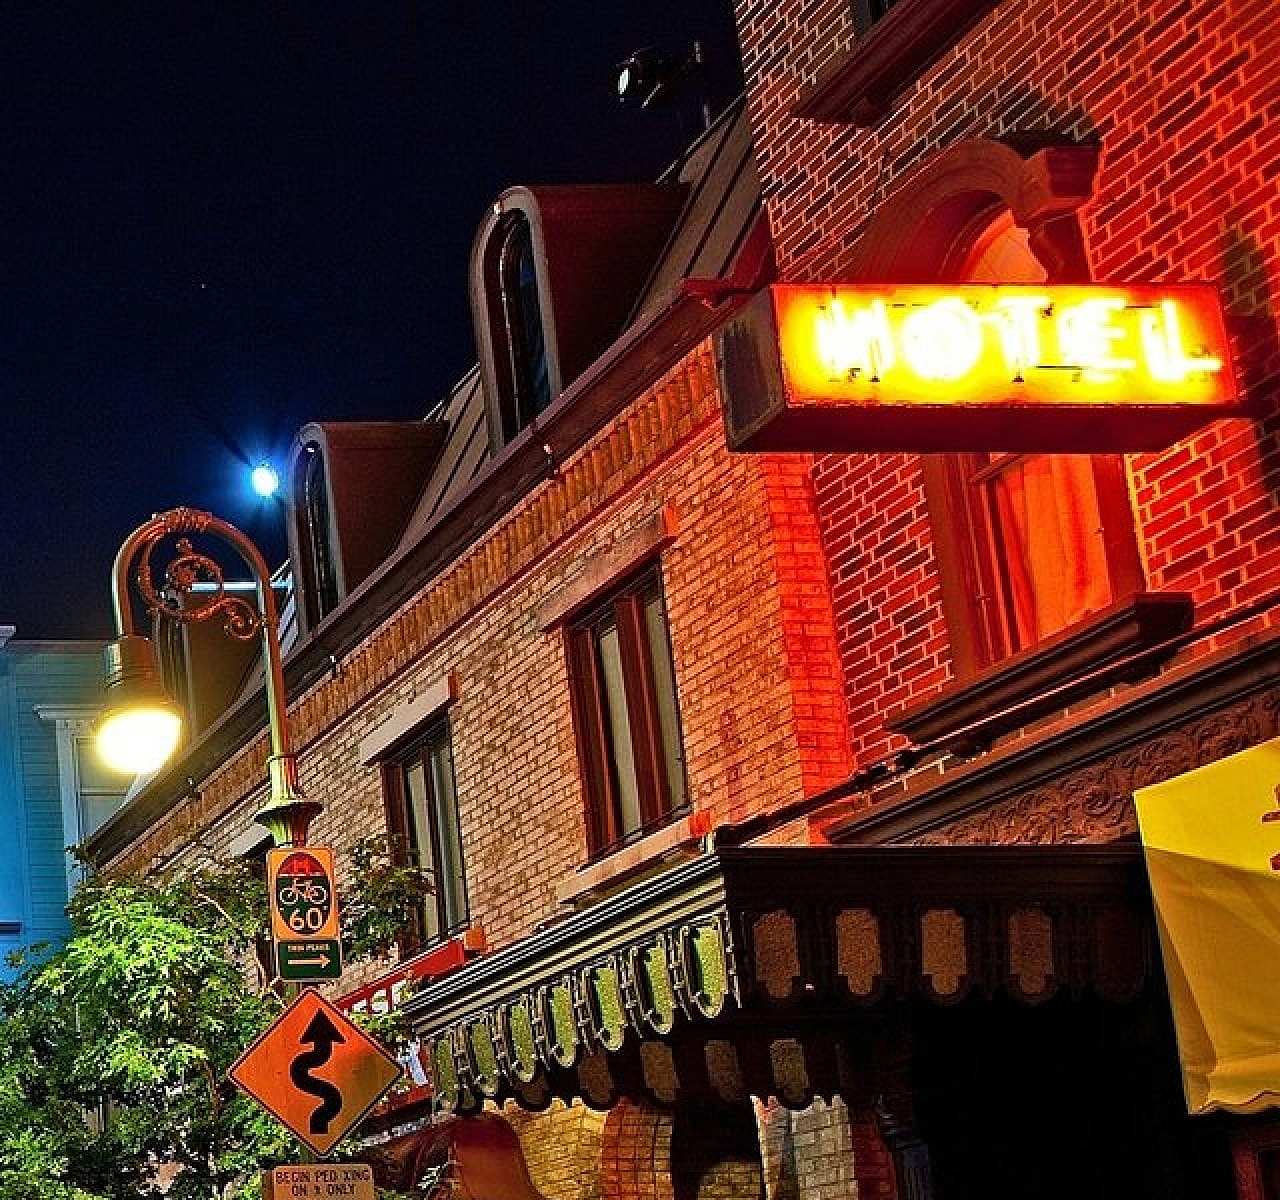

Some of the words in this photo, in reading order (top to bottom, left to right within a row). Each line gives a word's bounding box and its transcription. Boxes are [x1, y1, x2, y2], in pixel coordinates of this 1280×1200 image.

[816, 296, 1223, 384] MOTEL
[289, 907, 323, 930] 60
[276, 1171, 311, 1184] BEGIN
[315, 1170, 337, 1183] PED
[343, 1170, 371, 1182] XING
[291, 1184, 308, 1197] ON
[327, 1183, 356, 1196] ONLY
